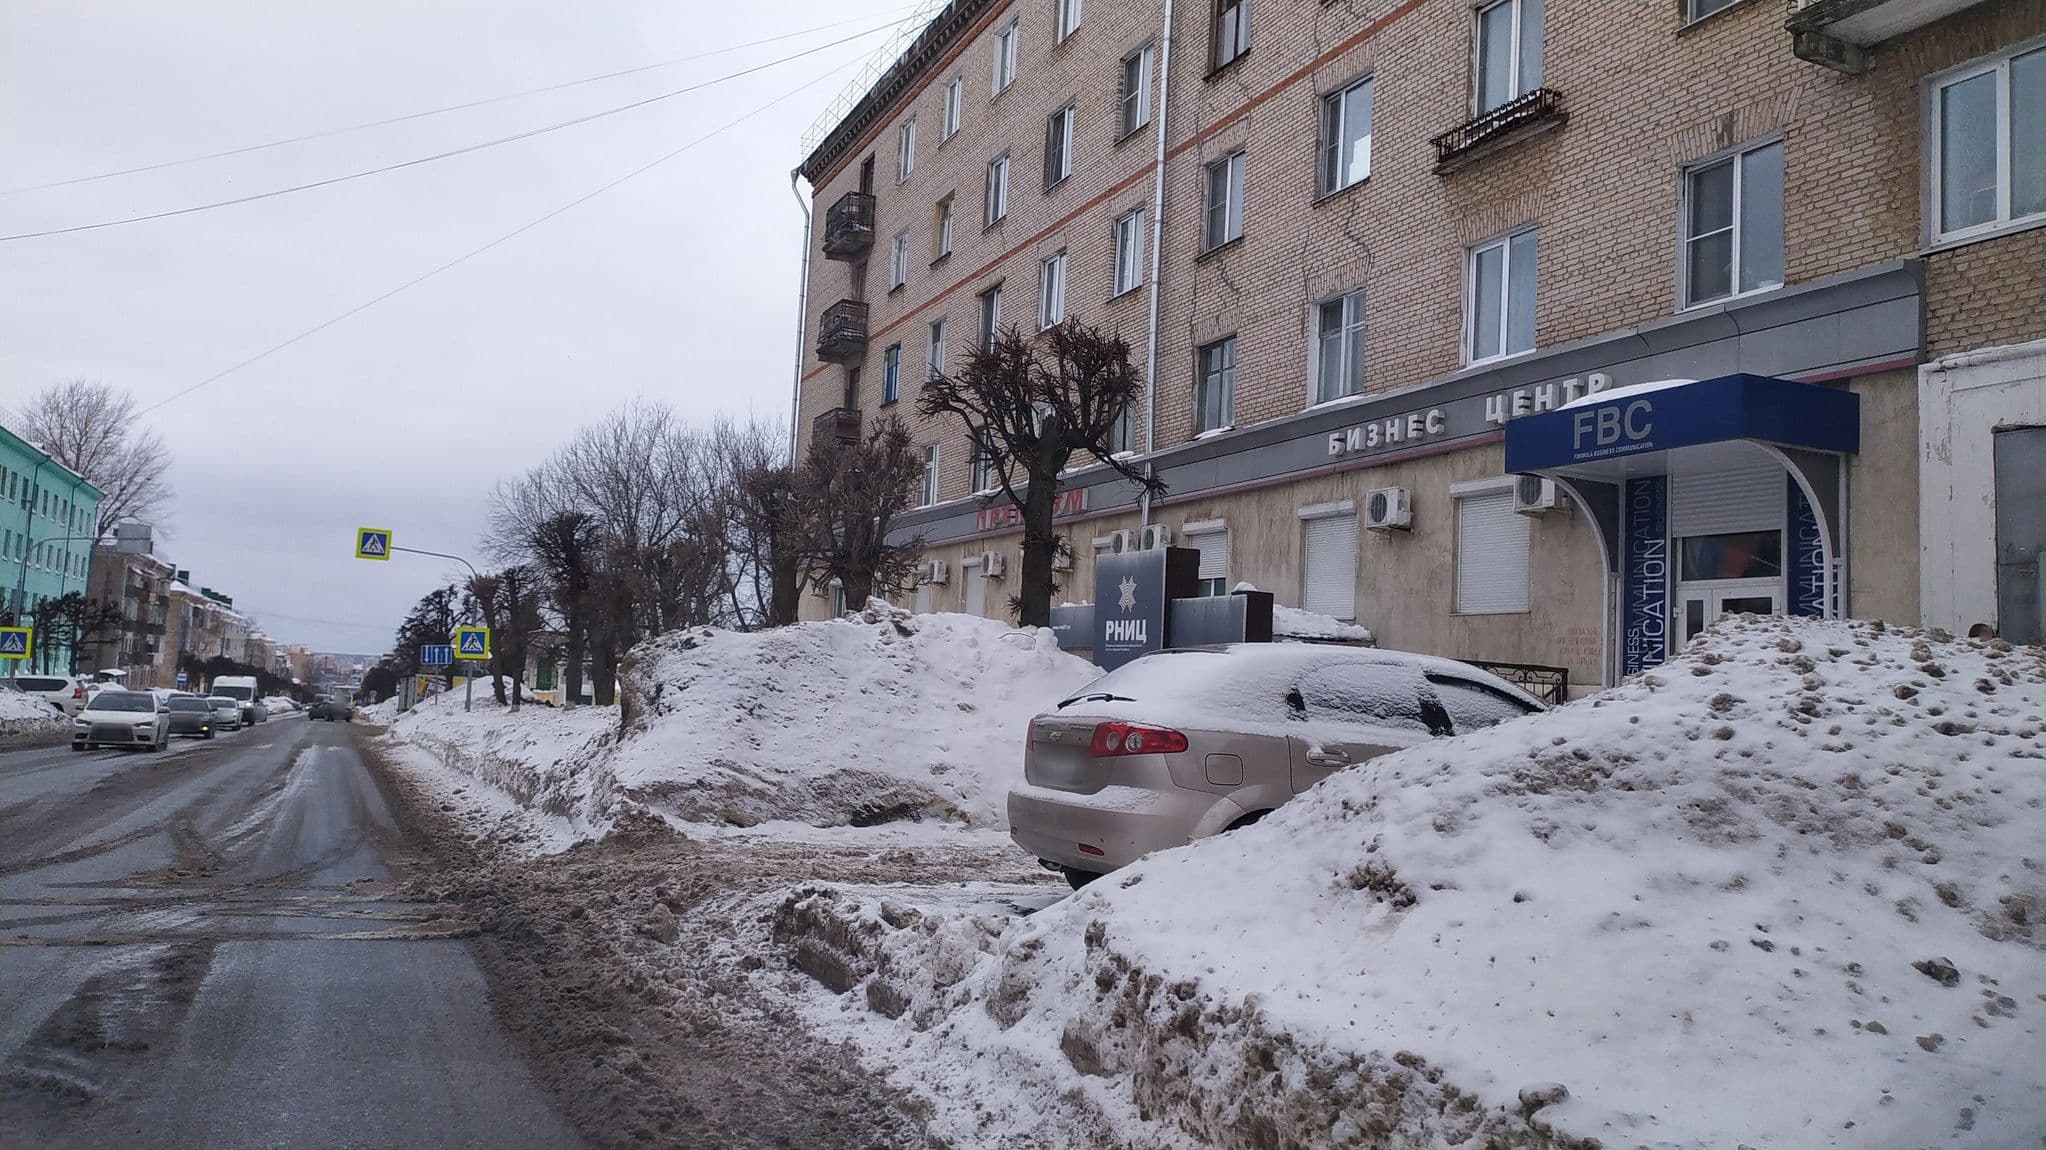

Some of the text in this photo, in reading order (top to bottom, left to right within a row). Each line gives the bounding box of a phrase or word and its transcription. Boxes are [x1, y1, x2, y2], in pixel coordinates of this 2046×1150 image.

[1328, 373, 1611, 456] БИЗНЕС ЦЕНТР
[1573, 400, 1653, 450] FBC
[1105, 619, 1147, 645] РНИЦ
